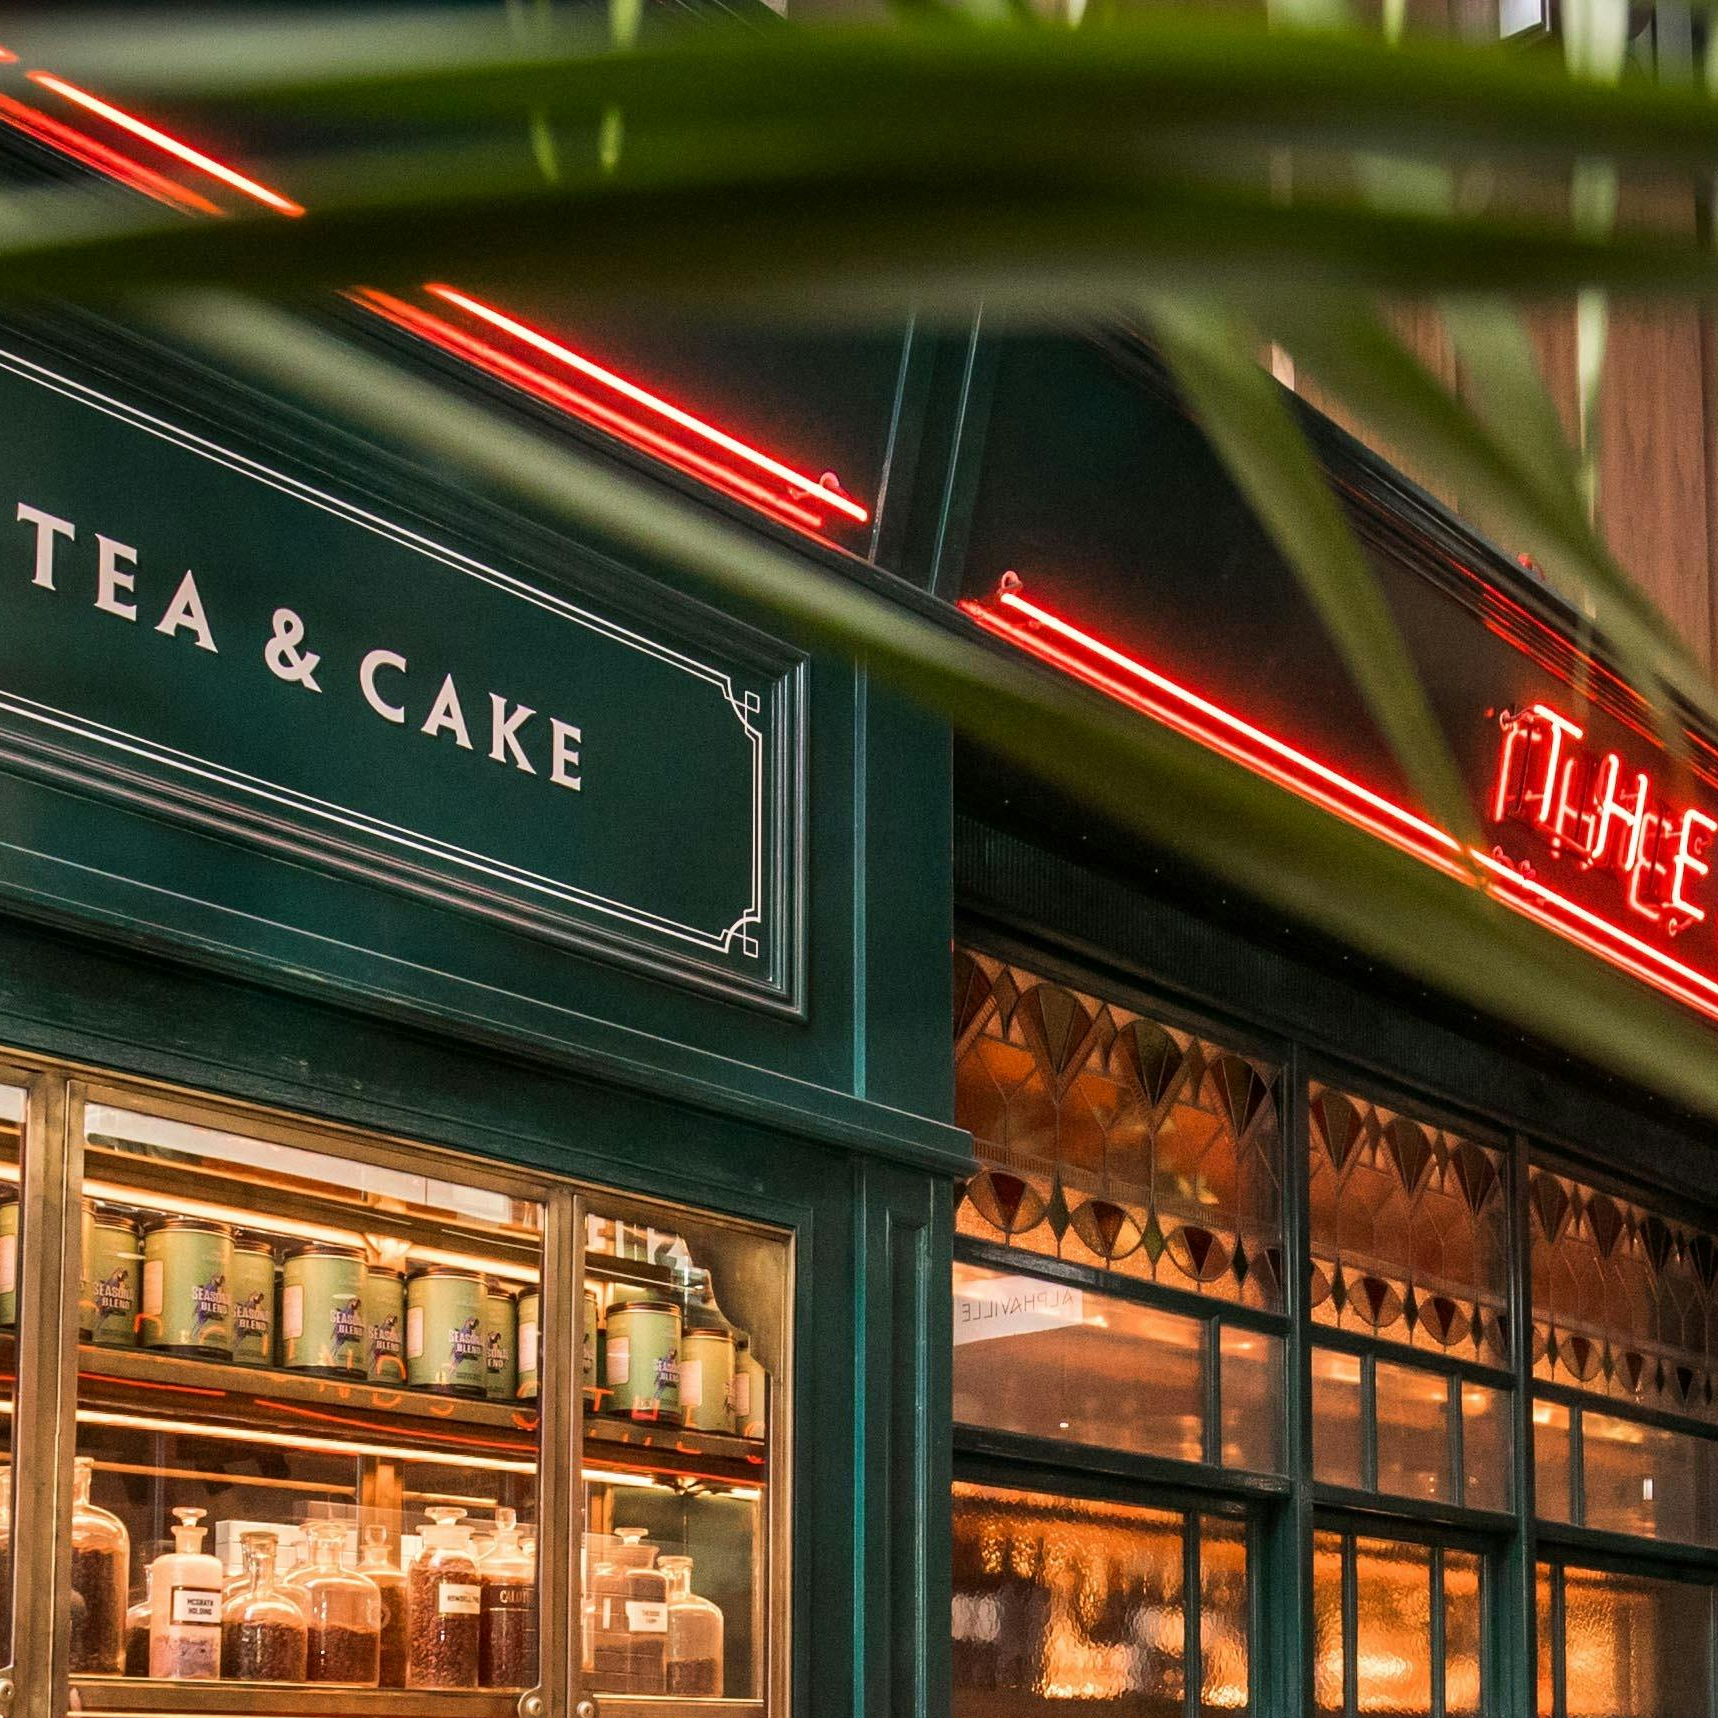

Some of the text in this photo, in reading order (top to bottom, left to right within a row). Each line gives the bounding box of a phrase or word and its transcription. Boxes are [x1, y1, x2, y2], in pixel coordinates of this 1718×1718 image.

[16, 501, 583, 792] TEA & CAKE
[1531, 703, 1718, 922] THE
[93, 1283, 135, 1302] SEASON
[193, 1286, 232, 1308] SEASO
[101, 1297, 130, 1310] BLEND
[200, 1301, 228, 1316] BLEND
[238, 1319, 268, 1332] BLEND
